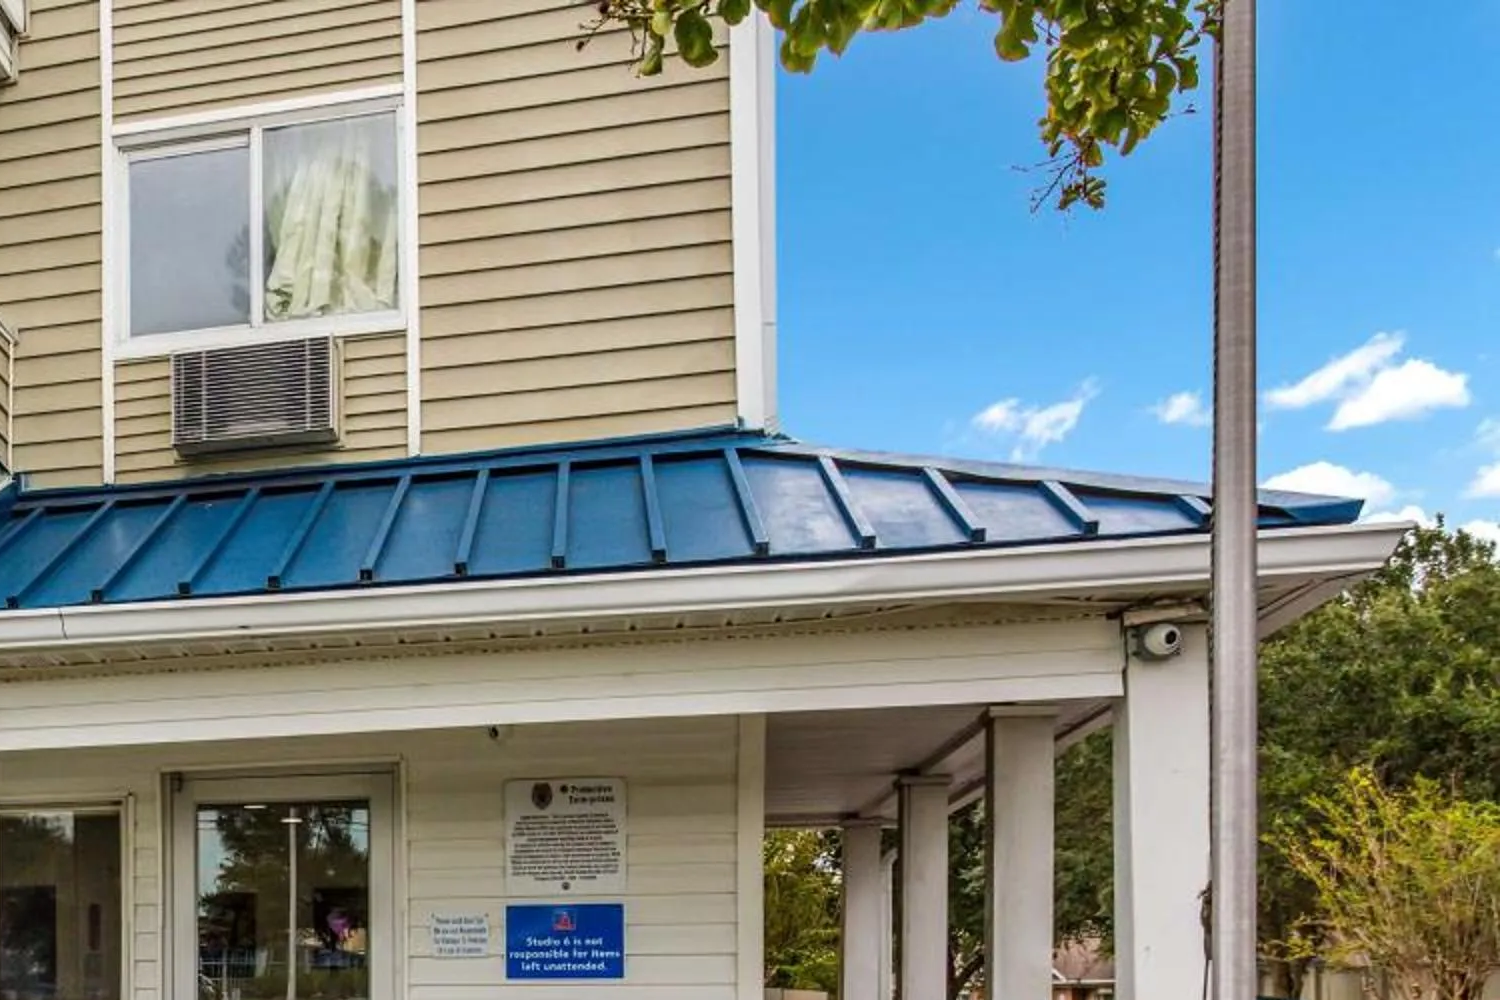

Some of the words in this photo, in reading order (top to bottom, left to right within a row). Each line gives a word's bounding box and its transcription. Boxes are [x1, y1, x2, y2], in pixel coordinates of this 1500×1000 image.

[525, 937, 561, 947] Studio
[563, 937, 571, 947] 6
[573, 937, 583, 947] is
[584, 937, 603, 946] not
[509, 947, 570, 959] responsible
[572, 947, 588, 958] for
[521, 961, 540, 971] left
